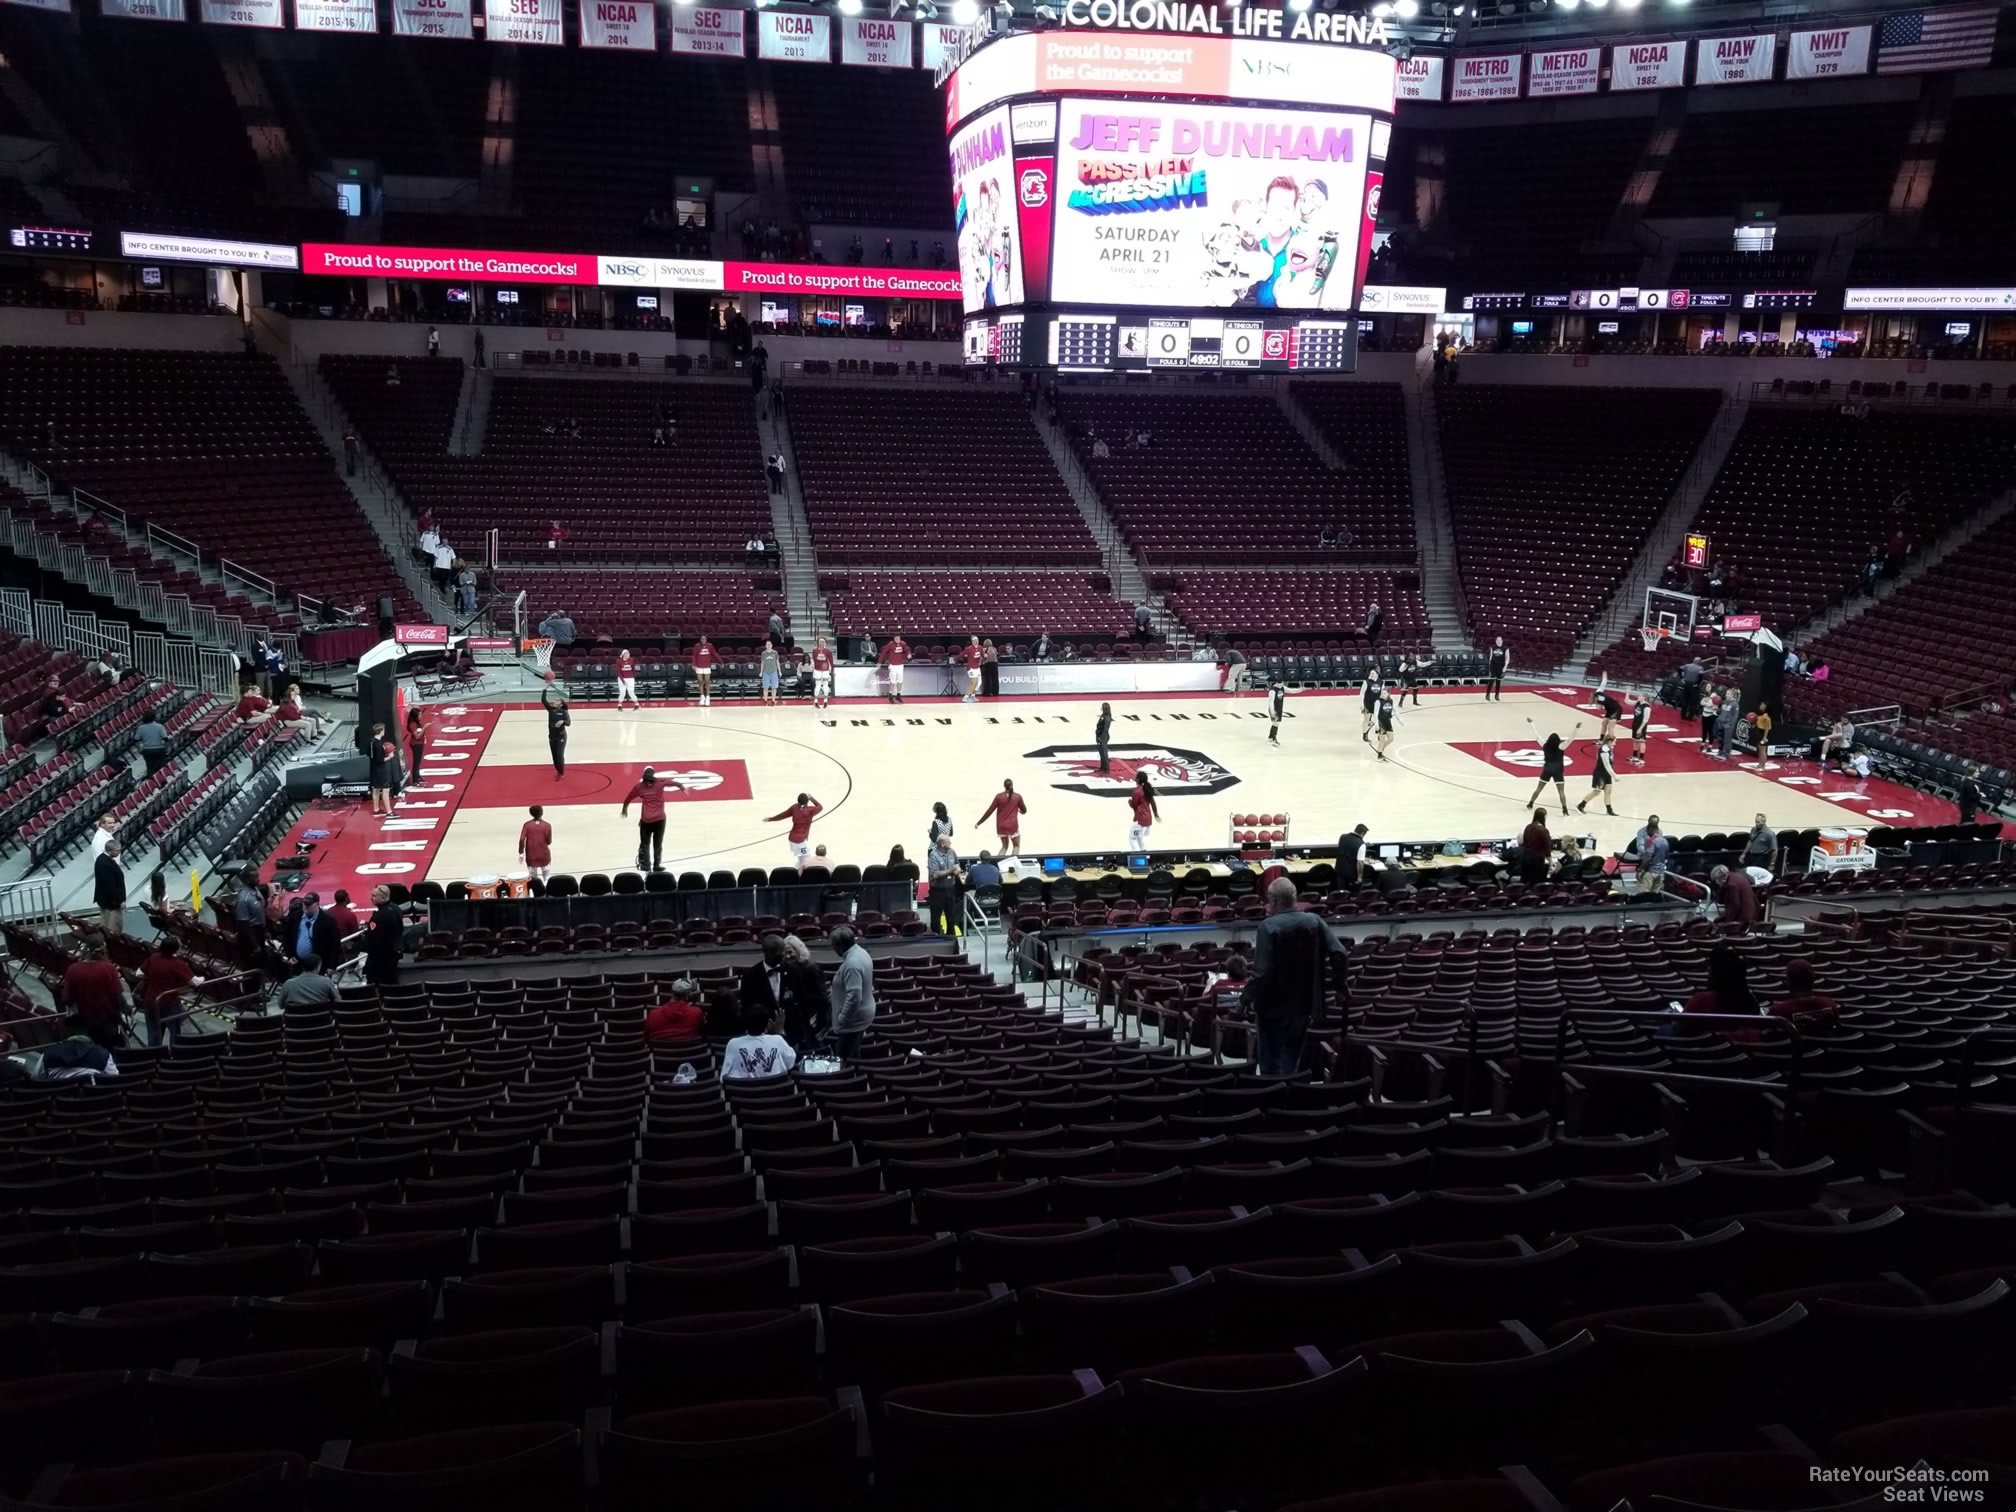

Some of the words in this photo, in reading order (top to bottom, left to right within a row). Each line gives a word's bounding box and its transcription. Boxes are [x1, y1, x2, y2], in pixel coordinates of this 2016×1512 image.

[132, 4, 156, 15] 2016
[511, 0, 539, 15] SEC
[598, 4, 637, 23] NCAA
[230, 11, 253, 21] 2016
[319, 16, 355, 27] 2015-16
[694, 11, 721, 28] SEC
[1066, 0, 1223, 33] COLONIAL
[1232, 8, 1284, 37] LIFE
[1290, 12, 1388, 46] ARENA
[422, 23, 444, 33] 2015
[775, 17, 813, 34] NCAA
[858, 22, 896, 40] NCAA
[608, 34, 628, 45] 2014
[940, 28, 967, 45] NCA
[1810, 31, 1849, 51] NWIT
[692, 40, 724, 51] 2013-14
[784, 47, 804, 57] 2013
[1716, 39, 1756, 58] AIAW
[867, 53, 887, 63] 2012
[1046, 43, 1101, 60] Proud
[1104, 44, 1122, 59] to
[1124, 45, 1194, 65] support
[1542, 53, 1587, 70] METRO
[1629, 46, 1668, 64] NCAA
[1814, 51, 1842, 59] CHAMPION
[1046, 64, 1076, 82] the
[1078, 66, 1185, 84] Gamecocks!
[1397, 60, 1429, 76] NCAA
[1465, 59, 1510, 76] METRO
[1723, 69, 1744, 79] 1980
[1815, 63, 1837, 73] 1979
[1637, 76, 1656, 86] 1982
[1403, 87, 1420, 96] 1986
[1069, 114, 1161, 153] JEFF
[1172, 118, 1353, 162] DUNHAM
[956, 122, 1006, 180] DUNHAM
[1077, 157, 1195, 182] PASSIVELY
[1067, 169, 1208, 211] AGGRESSIVE
[1094, 226, 1180, 243] SATURDAY
[128, 242, 147, 250] INFO
[150, 243, 179, 252] CENTER
[181, 245, 217, 255] BROUGHT
[219, 248, 229, 256] TO
[248, 251, 260, 259] BY:
[1099, 248, 1146, 263] APRIL
[1152, 250, 1171, 264] 21
[324, 252, 372, 269] Proud
[375, 254, 392, 269] to
[395, 256, 456, 275] support
[458, 257, 483, 272] the
[485, 259, 577, 276] Gamecocks!
[605, 264, 645, 277] NBSC
[660, 264, 705, 276] SYNOVUS
[742, 269, 786, 287] Proud
[788, 273, 803, 287] to
[804, 275, 861, 292] support
[862, 276, 886, 290] the
[1393, 292, 1430, 302] SYNOVUS
[1599, 294, 1610, 307] 0
[1647, 293, 1659, 307] 0
[1161, 334, 1176, 353] 0
[1235, 336, 1250, 354] 0
[1190, 355, 1218, 365] 49:02
[1690, 547, 1703, 564] 30
[1015, 676, 1038, 684] BUILD
[820, 717, 952, 728] ARENA
[983, 715, 1070, 725] LIFE
[355, 725, 485, 875] GAMECOCKS
[482, 890, 491, 898] G
[516, 884, 524, 892] G
[738, 1046, 779, 1073] W
